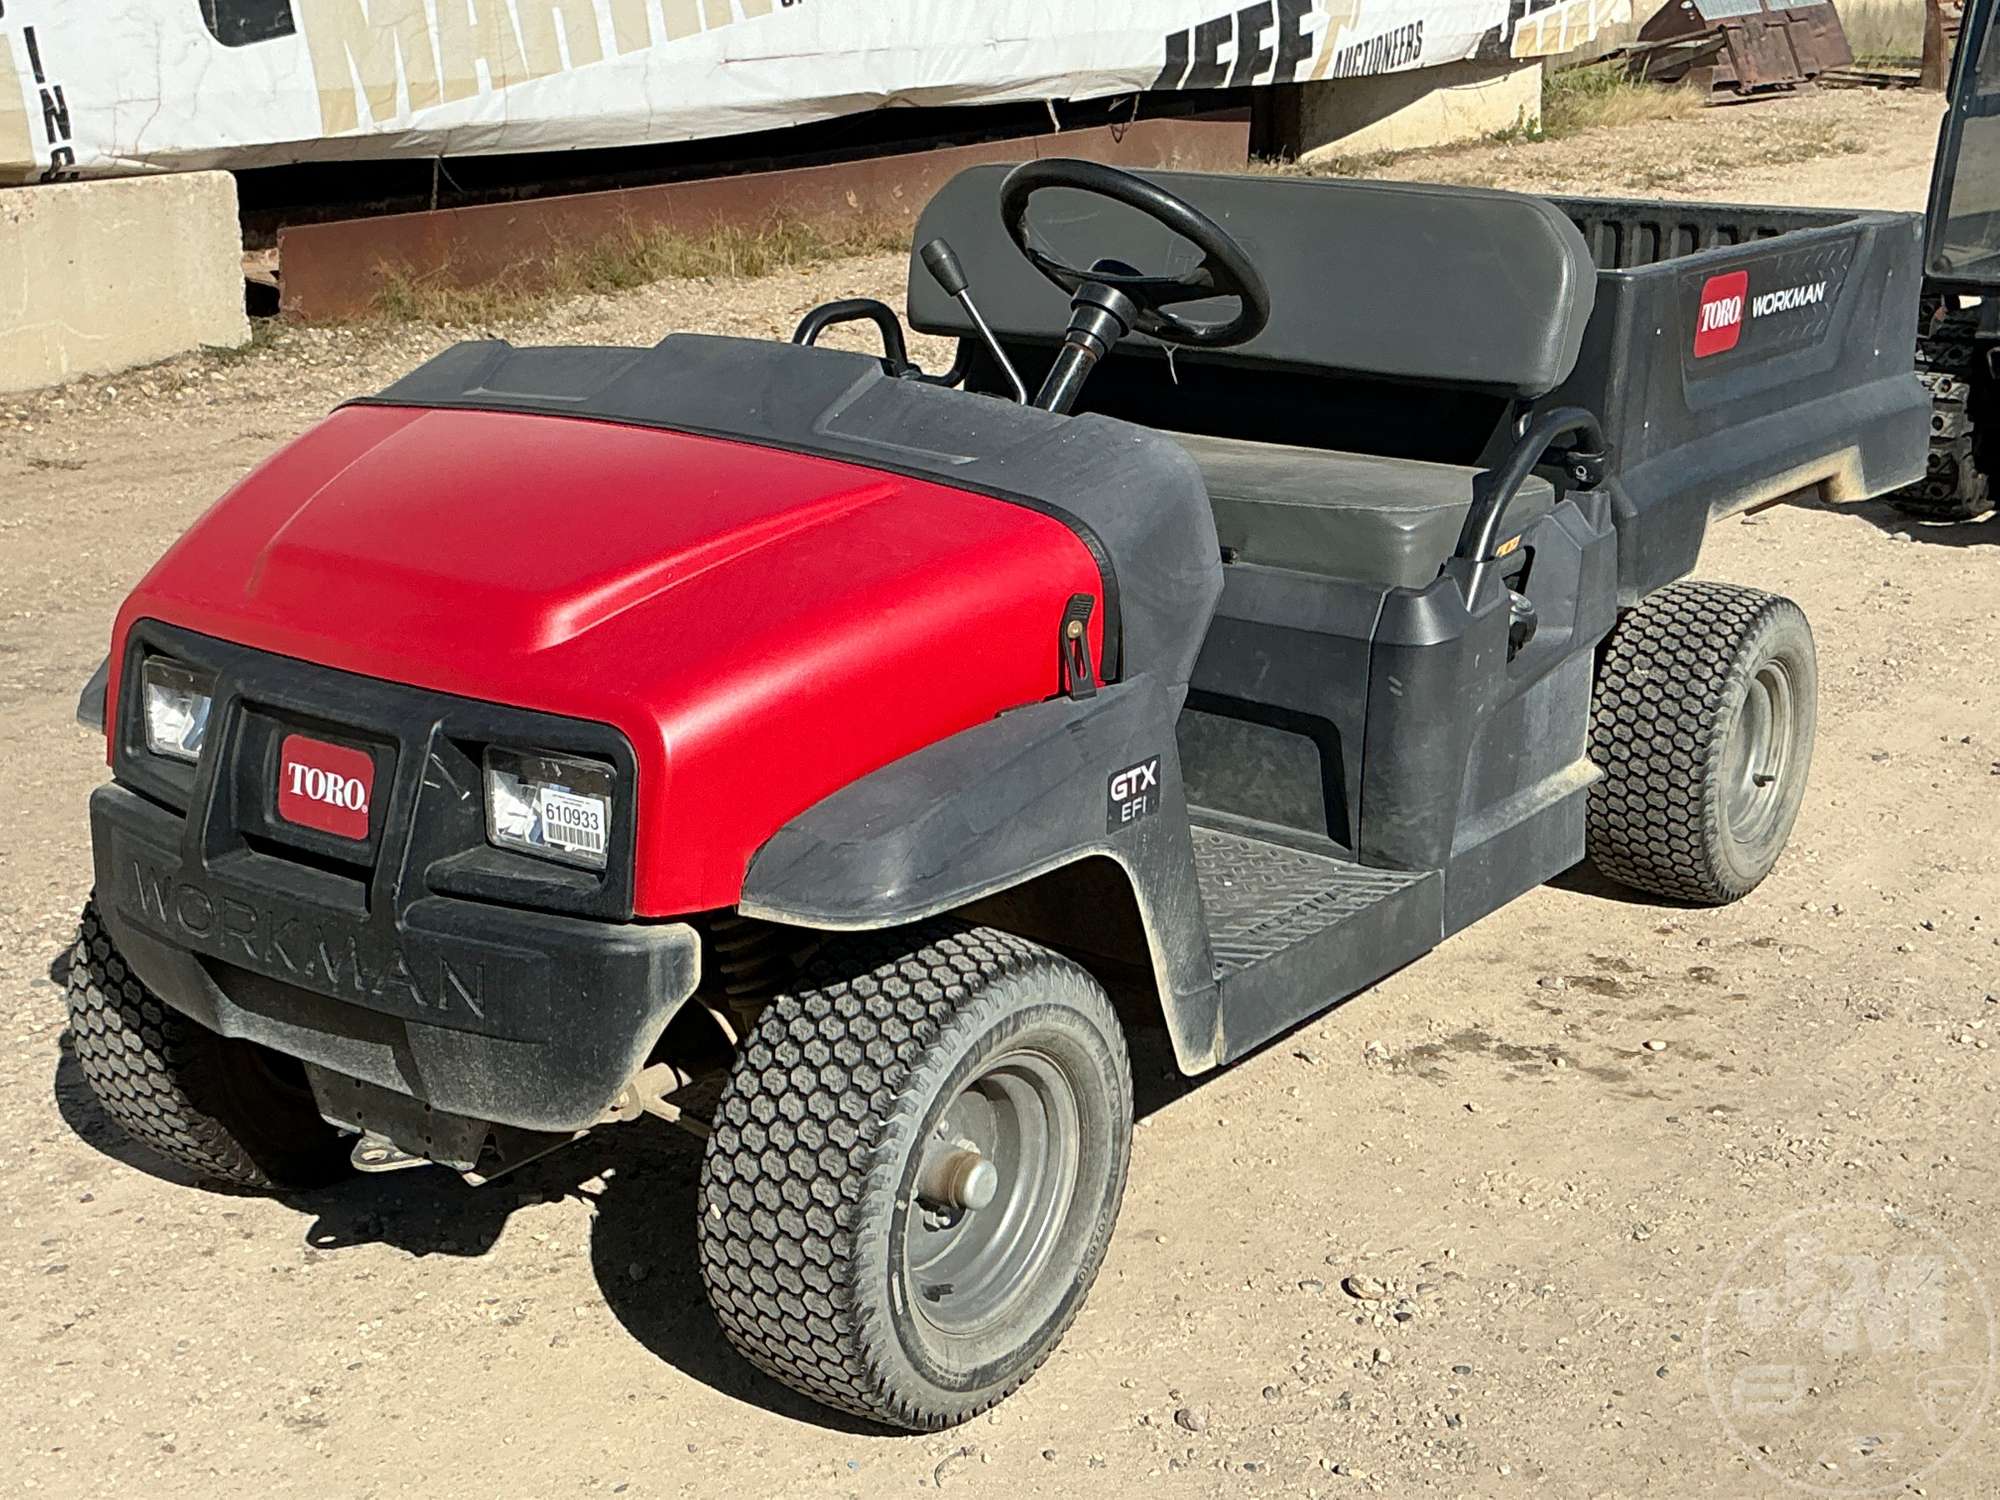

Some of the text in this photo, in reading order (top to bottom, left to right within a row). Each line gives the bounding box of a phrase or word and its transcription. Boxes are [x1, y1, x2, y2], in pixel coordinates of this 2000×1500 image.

[1332, 20, 1424, 79] AUCTIONEERS
[1701, 281, 1827, 333] TORO WORKMAN
[288, 761, 365, 811] TORO
[1110, 760, 1157, 802] GTX
[545, 802, 599, 830] 610933
[1121, 796, 1147, 822] EFI
[133, 861, 486, 1019] WORKMAN
